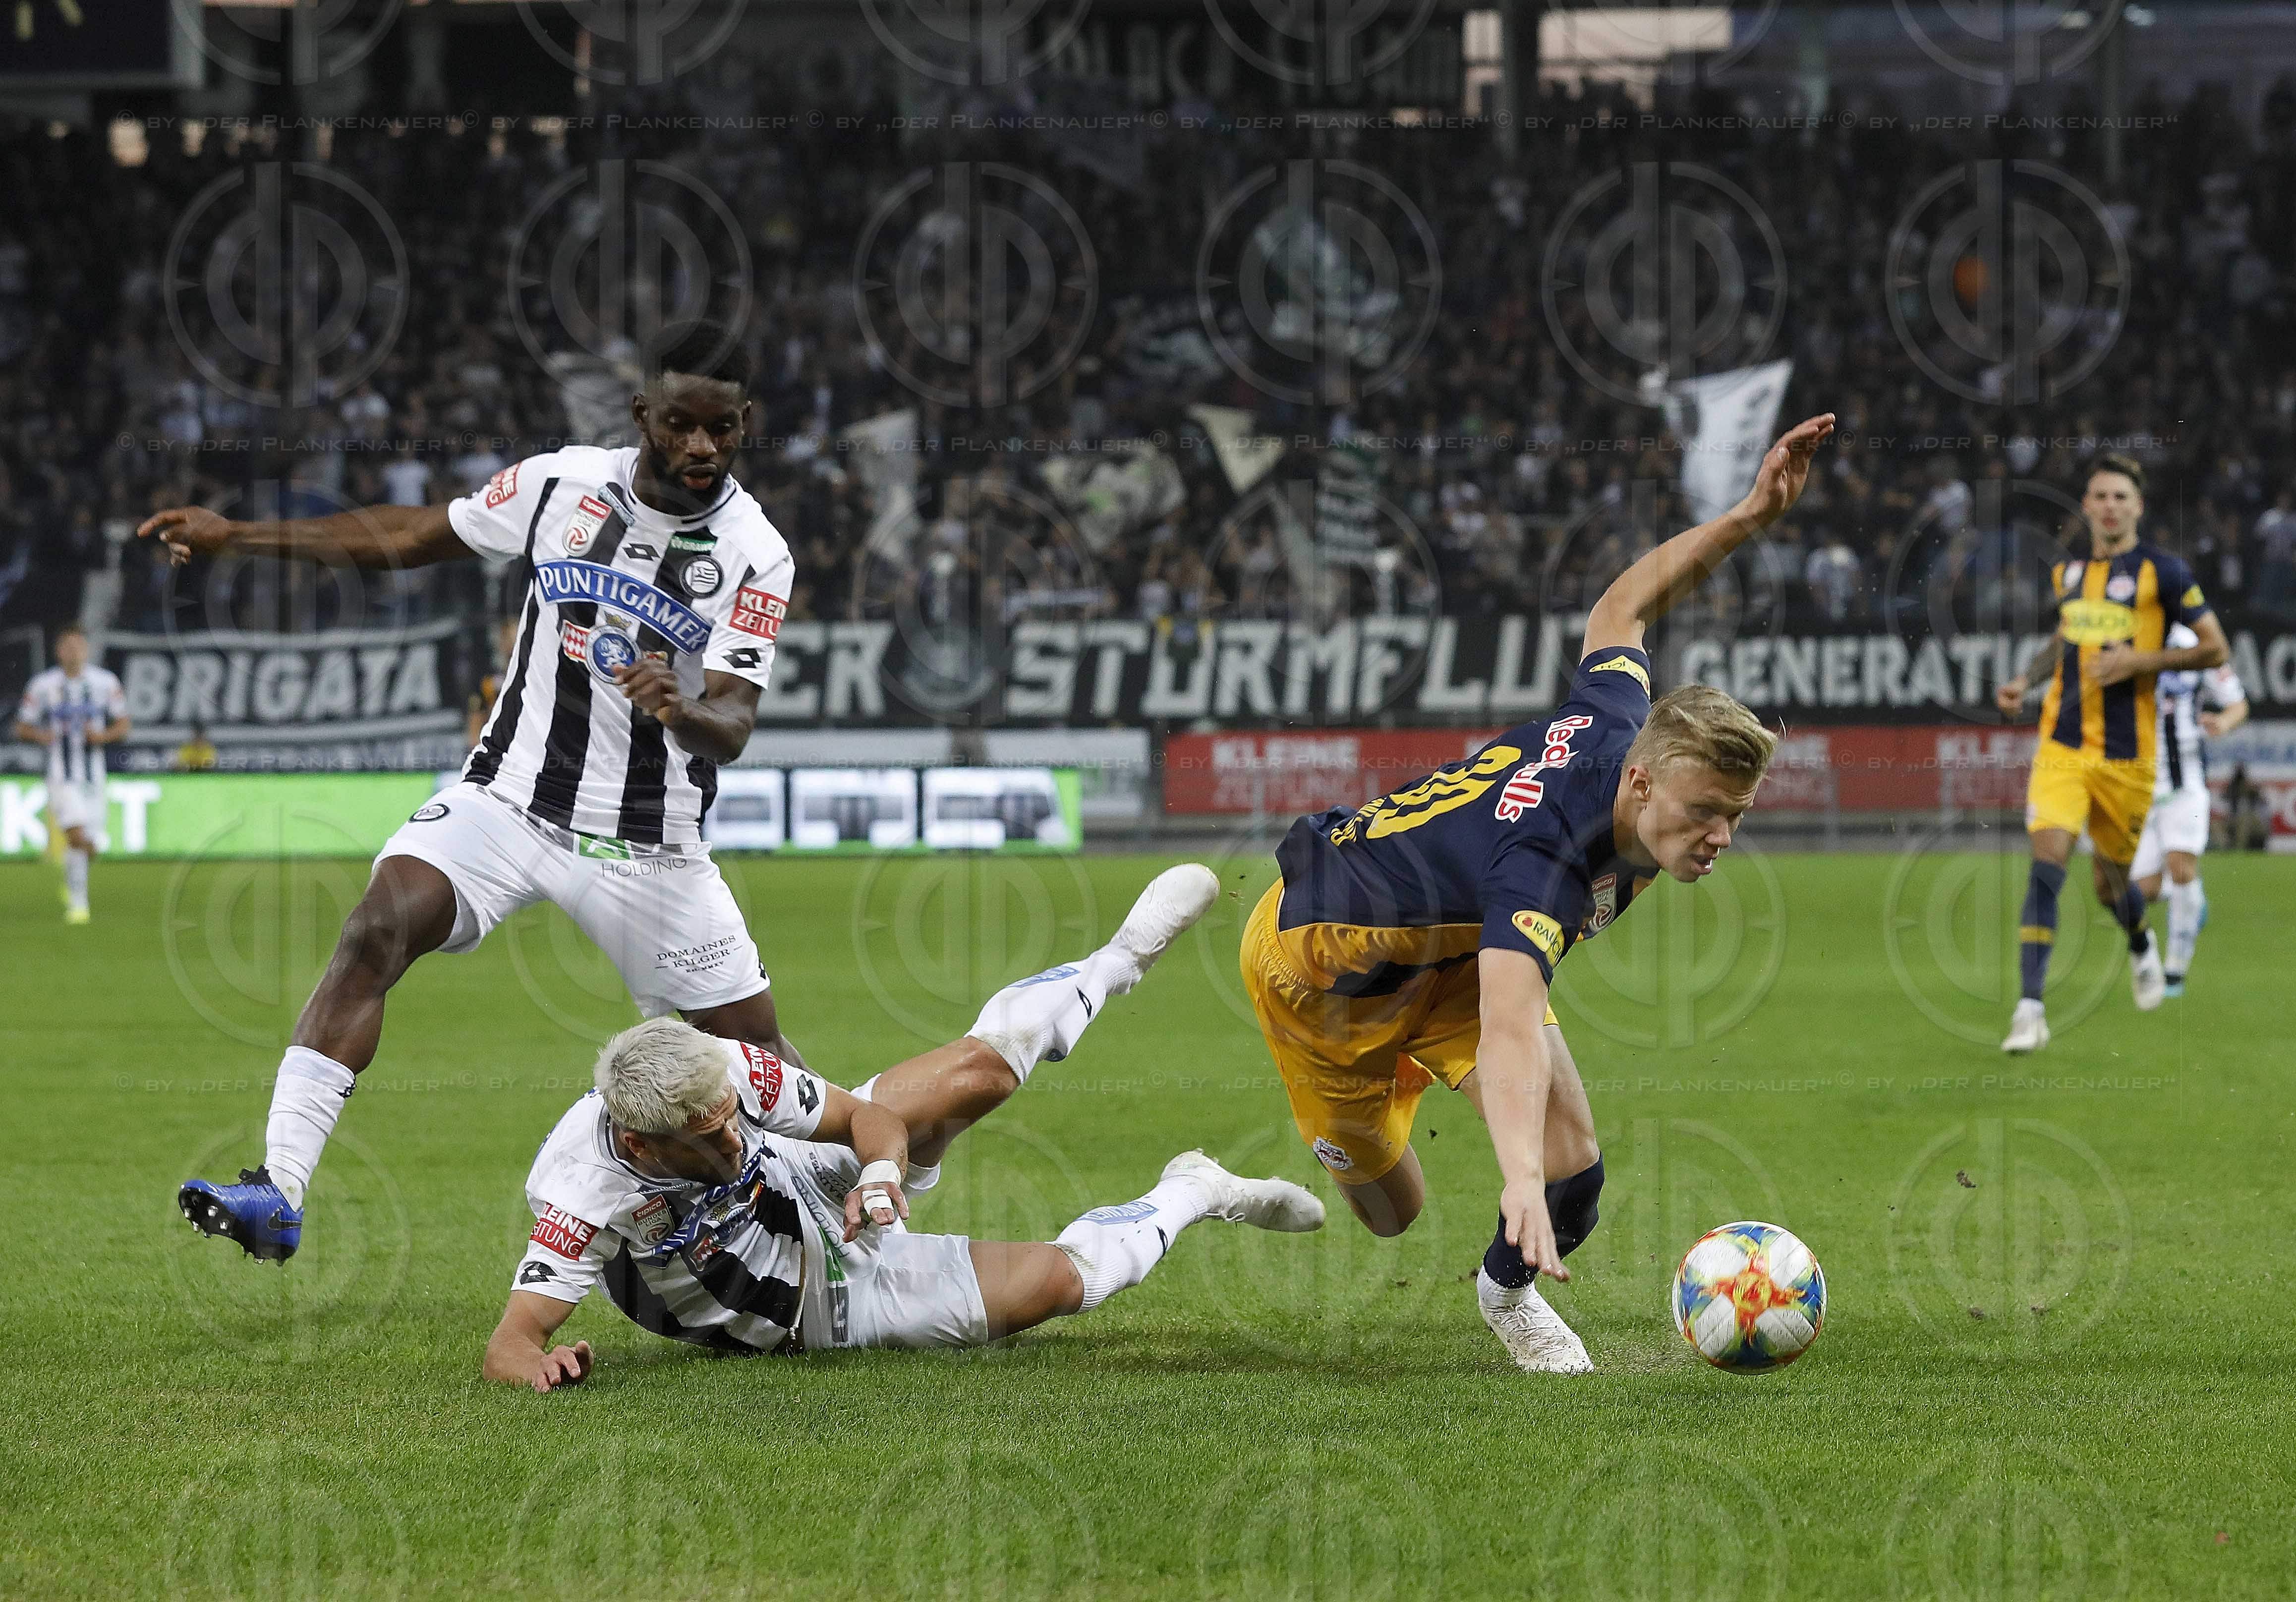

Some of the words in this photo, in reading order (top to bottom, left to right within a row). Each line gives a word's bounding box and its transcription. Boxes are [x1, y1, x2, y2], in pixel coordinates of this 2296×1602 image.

[739, 591, 787, 620] KLEIN
[734, 609, 781, 637] ZEITU
[125, 642, 442, 723] BRIGATA
[754, 620, 894, 717] ER
[601, 858, 687, 877] HOLDING
[656, 934, 737, 961] DOMAINES
[673, 949, 731, 968] KILGER
[761, 1047, 780, 1107] ZEITUN
[540, 1204, 592, 1243] LEINE
[636, 1201, 662, 1218] tipico
